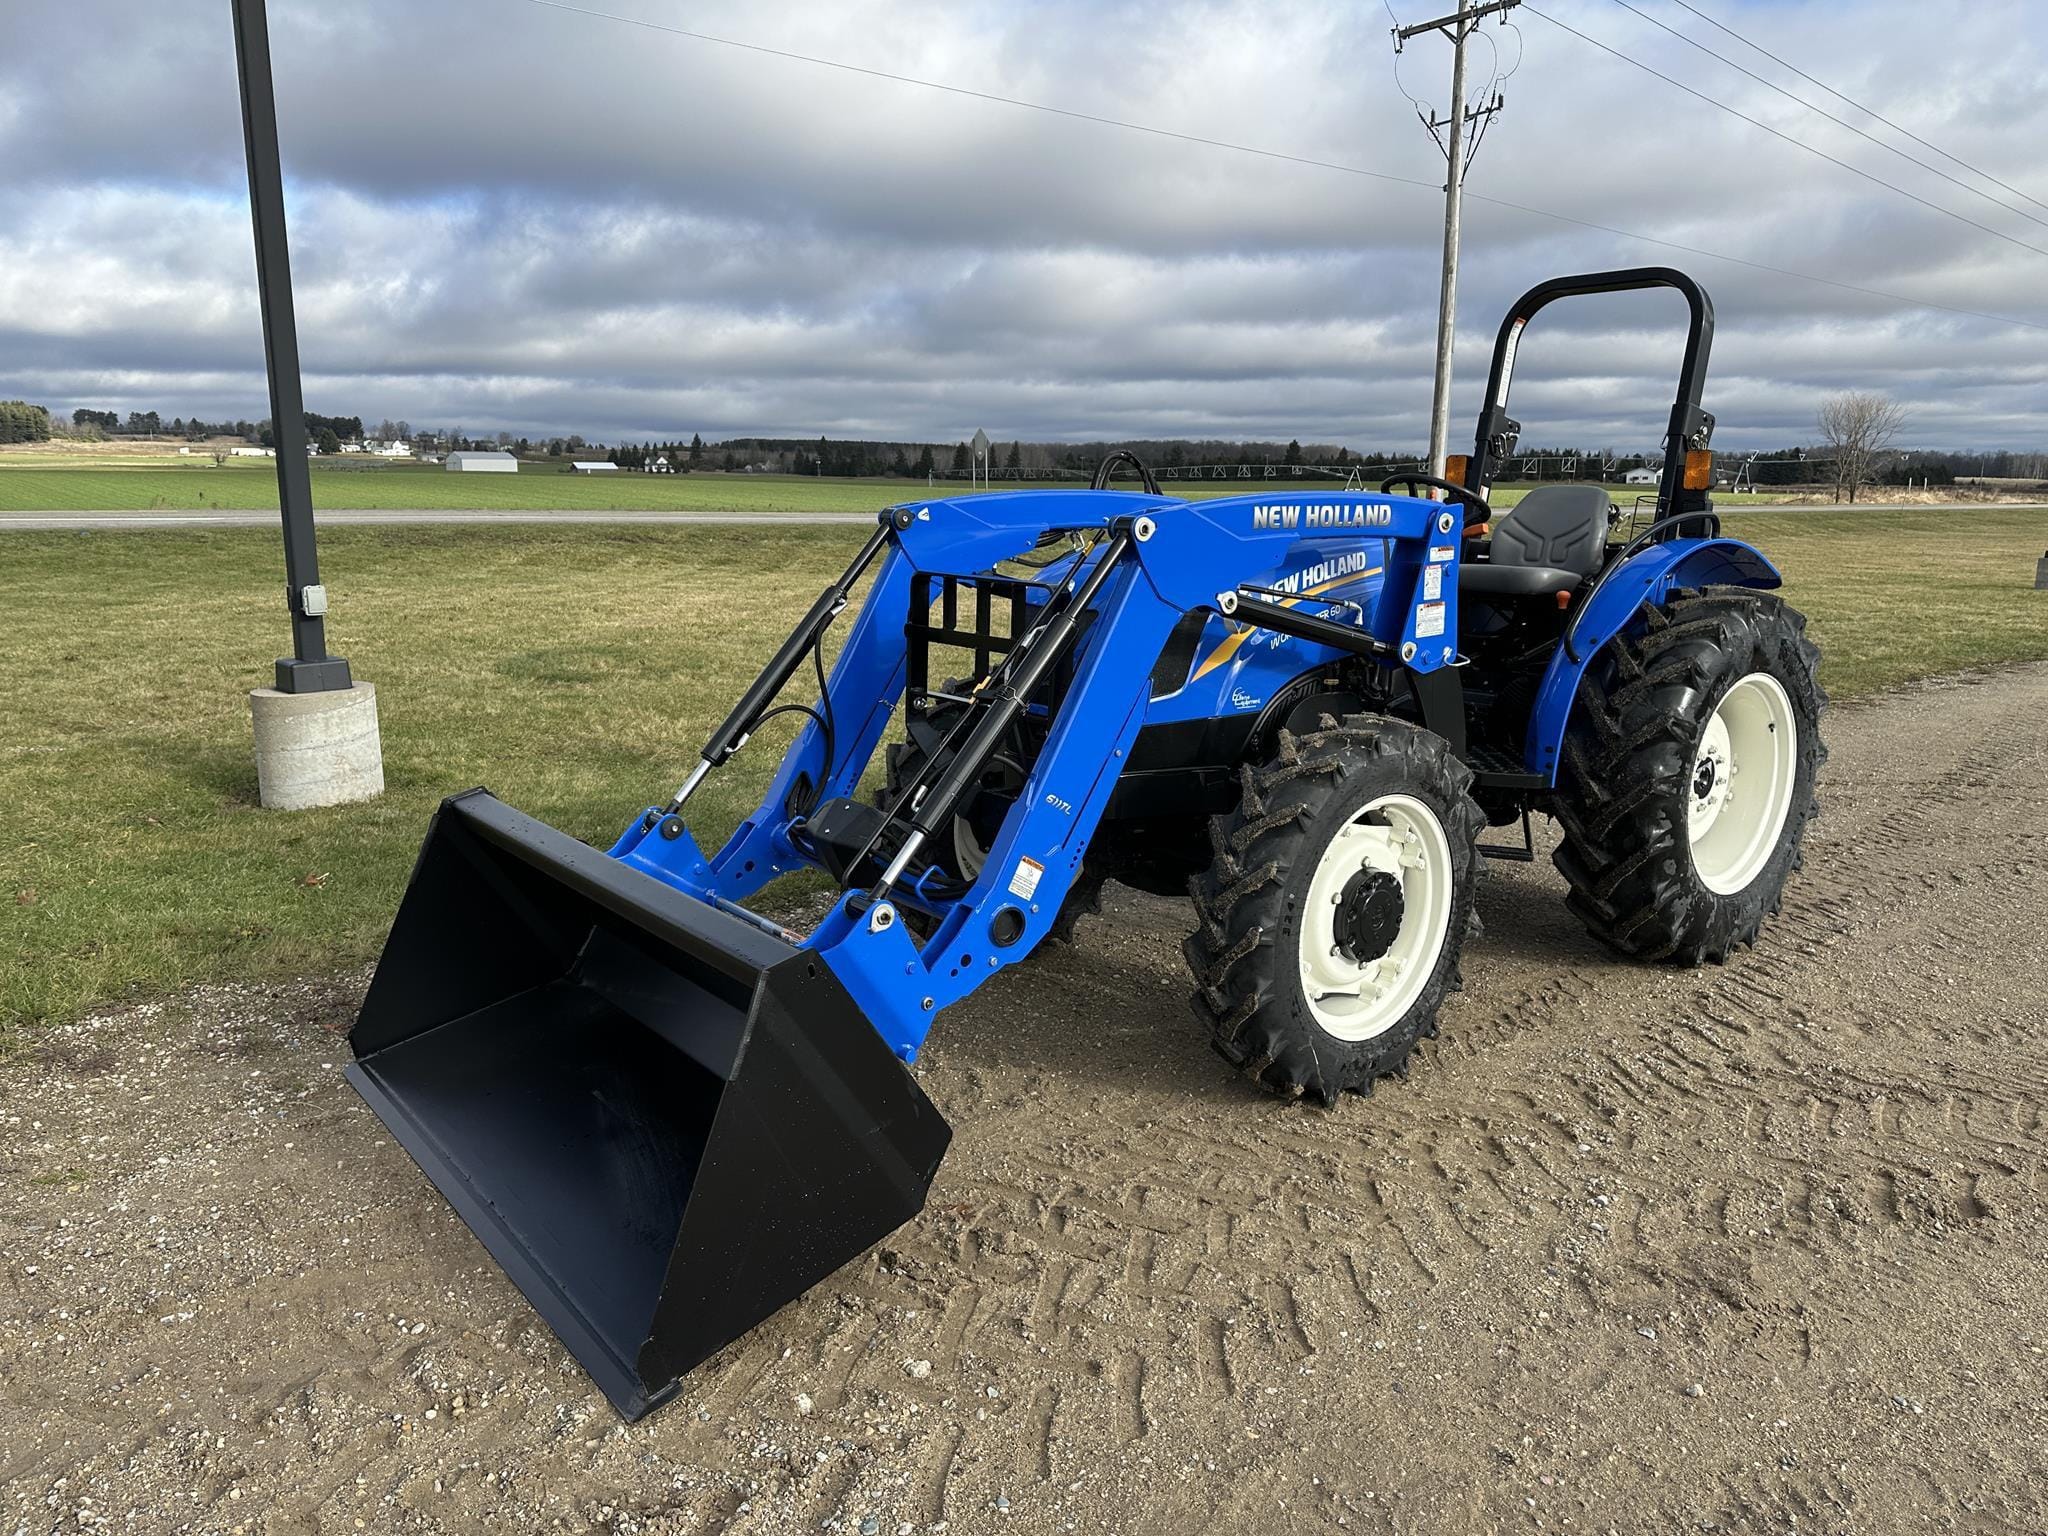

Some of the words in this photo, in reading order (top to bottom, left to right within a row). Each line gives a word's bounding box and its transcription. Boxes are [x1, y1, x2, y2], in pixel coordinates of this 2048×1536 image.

[1253, 505, 1300, 529] NEW
[1305, 504, 1392, 528] HOLLAND
[1302, 551, 1366, 589] HOLLAND
[1330, 604, 1341, 617] 60
[1045, 794, 1072, 815] 611TL
